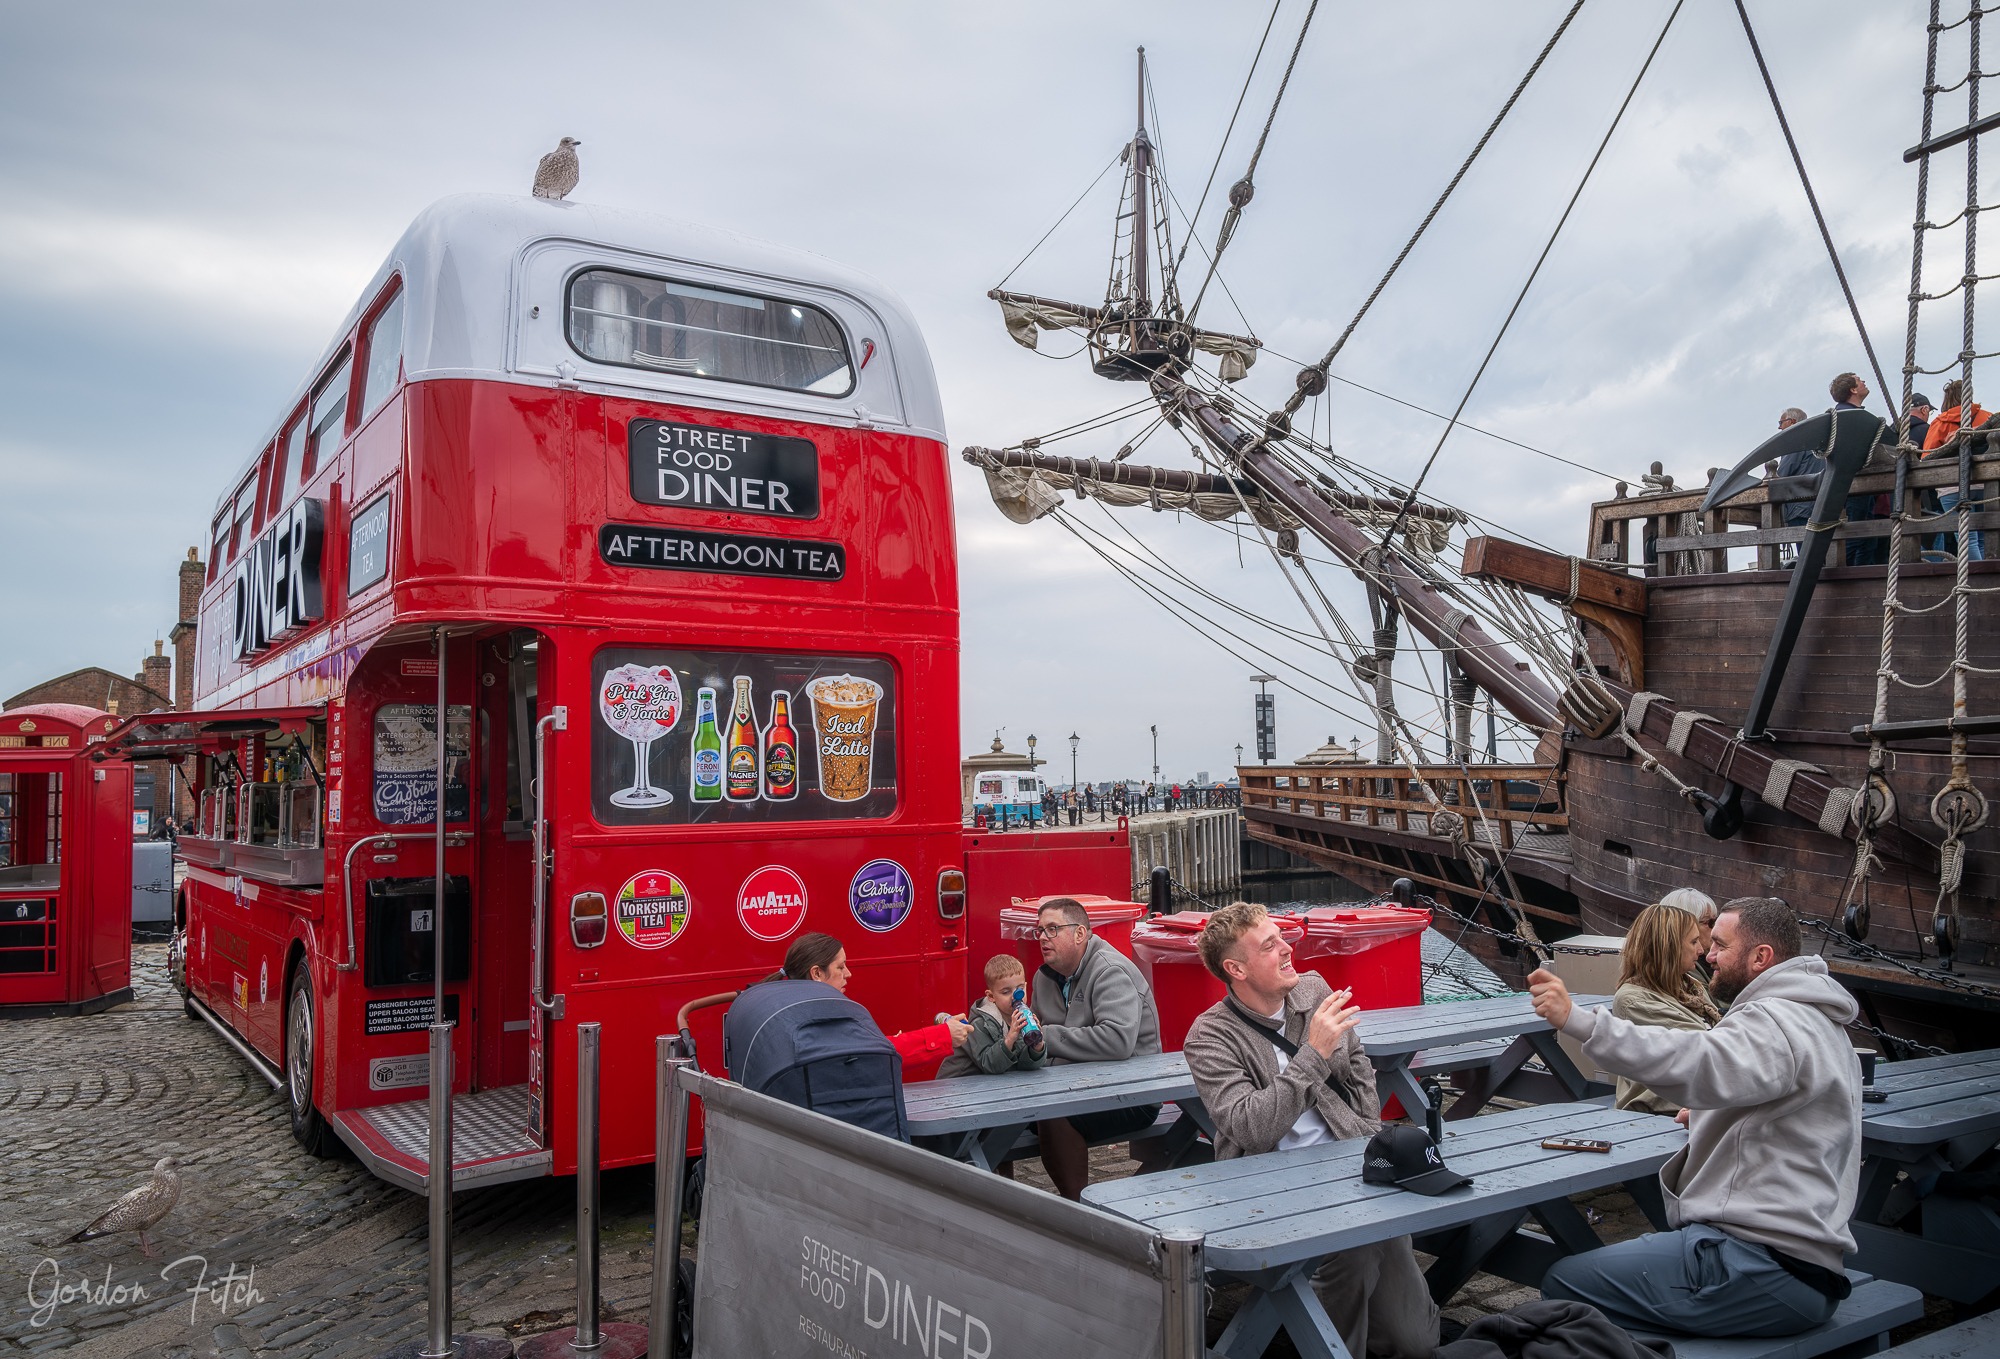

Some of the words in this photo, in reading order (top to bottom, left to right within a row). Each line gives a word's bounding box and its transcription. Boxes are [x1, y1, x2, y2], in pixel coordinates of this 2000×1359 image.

[657, 425, 752, 453] STREET
[657, 447, 732, 472] FOOD
[658, 468, 794, 513] DINER
[351, 508, 389, 553] AFTERNOON
[362, 551, 374, 576] TEA
[607, 535, 785, 569] AFTERNOON
[793, 549, 841, 573] TEA
[232, 498, 314, 663] DINER
[211, 639, 229, 681] FOOD
[607, 683, 647, 700] Pink
[649, 684, 677, 705] Gin
[613, 703, 628, 719] &
[631, 703, 670, 720] Tonic
[825, 714, 866, 734] Iced
[821, 736, 870, 756] Latte
[697, 762, 720, 770] PERONI
[728, 771, 758, 779] MAGNERS
[858, 879, 905, 897] Cadbury
[621, 900, 684, 916] YORKSHIRE
[742, 891, 802, 910] LAVAZZA
[643, 914, 664, 927] TEA
[369, 1001, 408, 1009] PASSENGER
[369, 1009, 390, 1017] UPPER
[392, 1007, 418, 1015] SALOON
[369, 1017, 392, 1025] LOWER
[393, 1015, 419, 1023] SALOON
[369, 1024, 401, 1032] STANDING
[801, 1235, 863, 1286] STREET
[800, 1264, 846, 1310] FOOD
[864, 1265, 992, 1359] DINER
